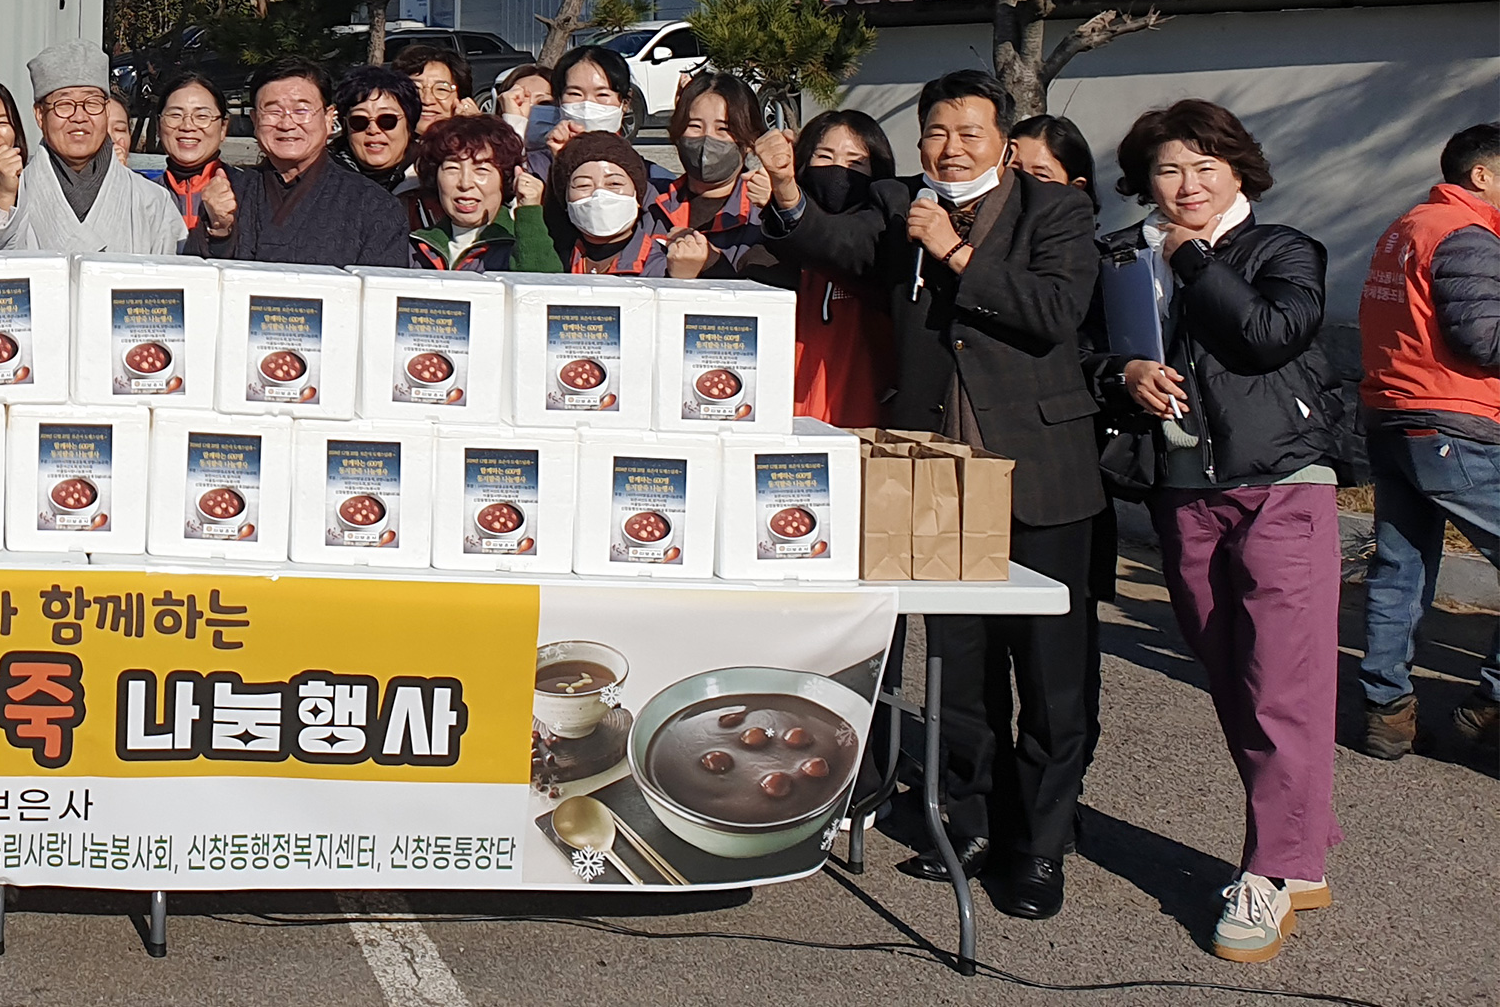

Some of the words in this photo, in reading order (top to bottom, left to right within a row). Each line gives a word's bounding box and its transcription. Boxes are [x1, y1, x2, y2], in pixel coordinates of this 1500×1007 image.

[40, 584, 251, 650] 함께하는
[119, 673, 464, 763] 나눔행사
[186, 834, 381, 873] 신창동행정복지센터,
[388, 835, 517, 872] 신창동통장단
